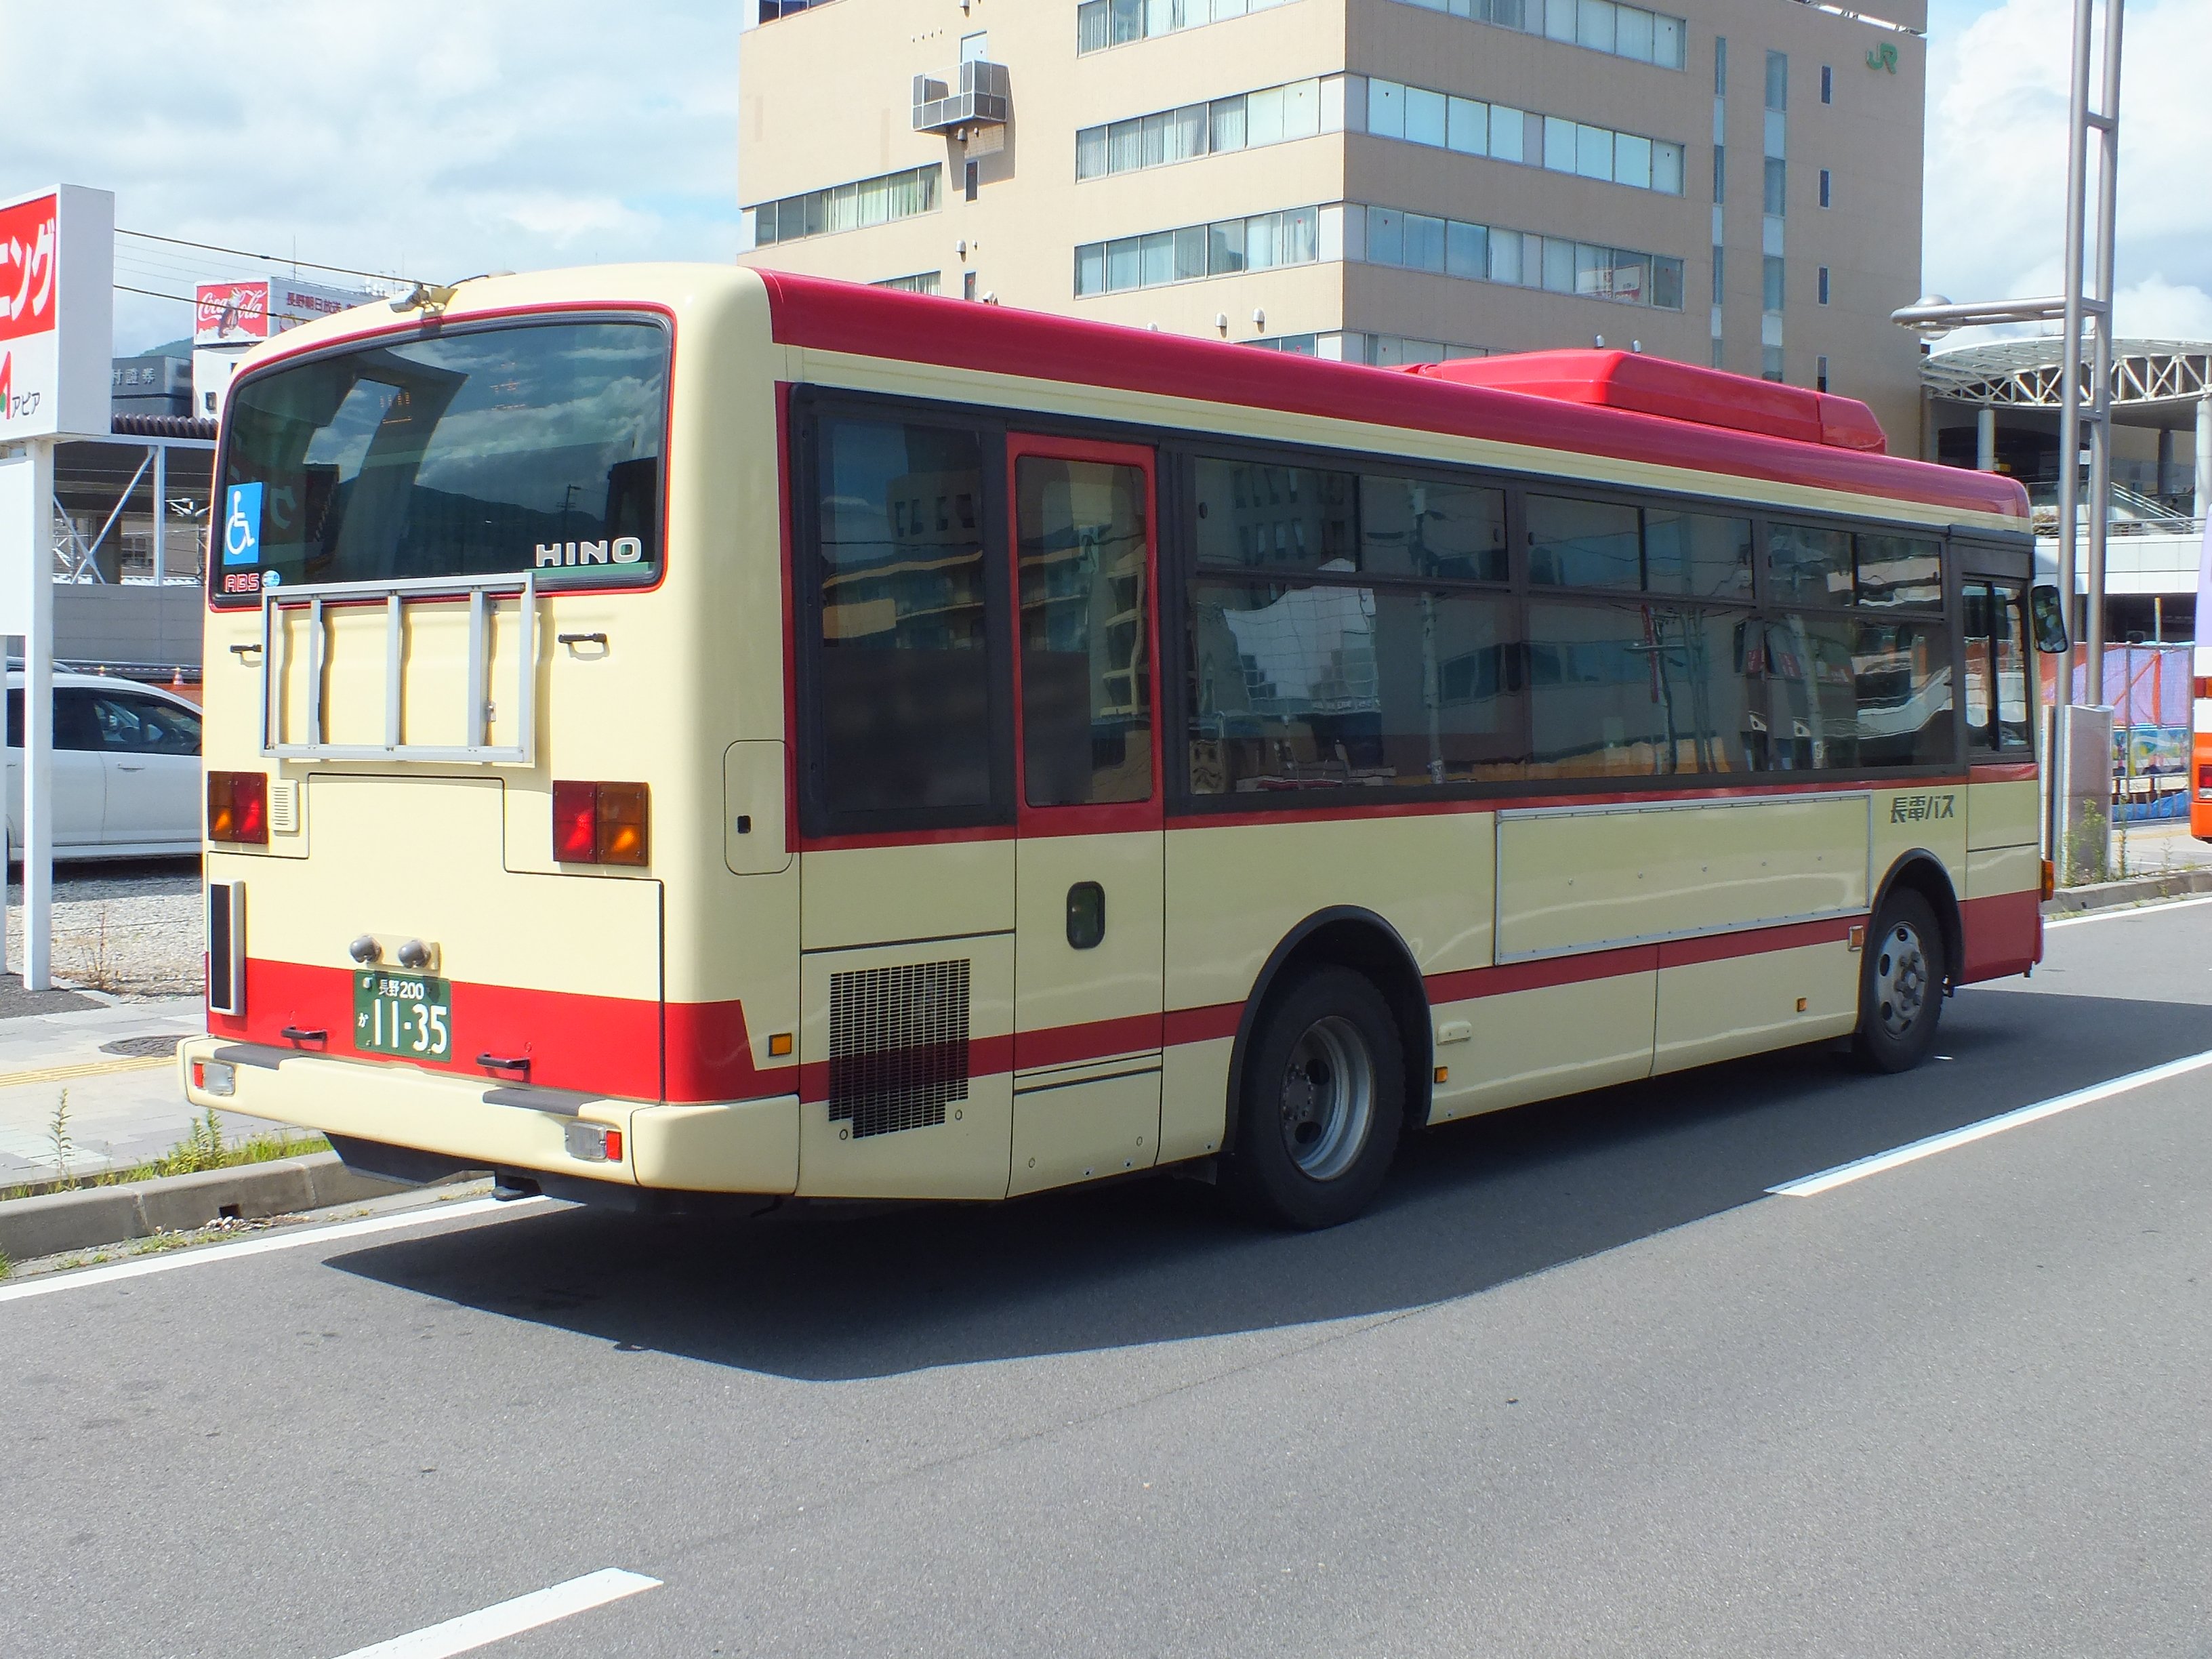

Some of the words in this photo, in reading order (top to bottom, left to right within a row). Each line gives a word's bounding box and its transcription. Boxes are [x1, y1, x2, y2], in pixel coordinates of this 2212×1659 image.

[1866, 43, 1898, 75] JR
[12, 391, 41, 418] アピア
[535, 537, 642, 567] HINO
[224, 573, 260, 593] ABS
[1890, 794, 1954, 823] 長電バス
